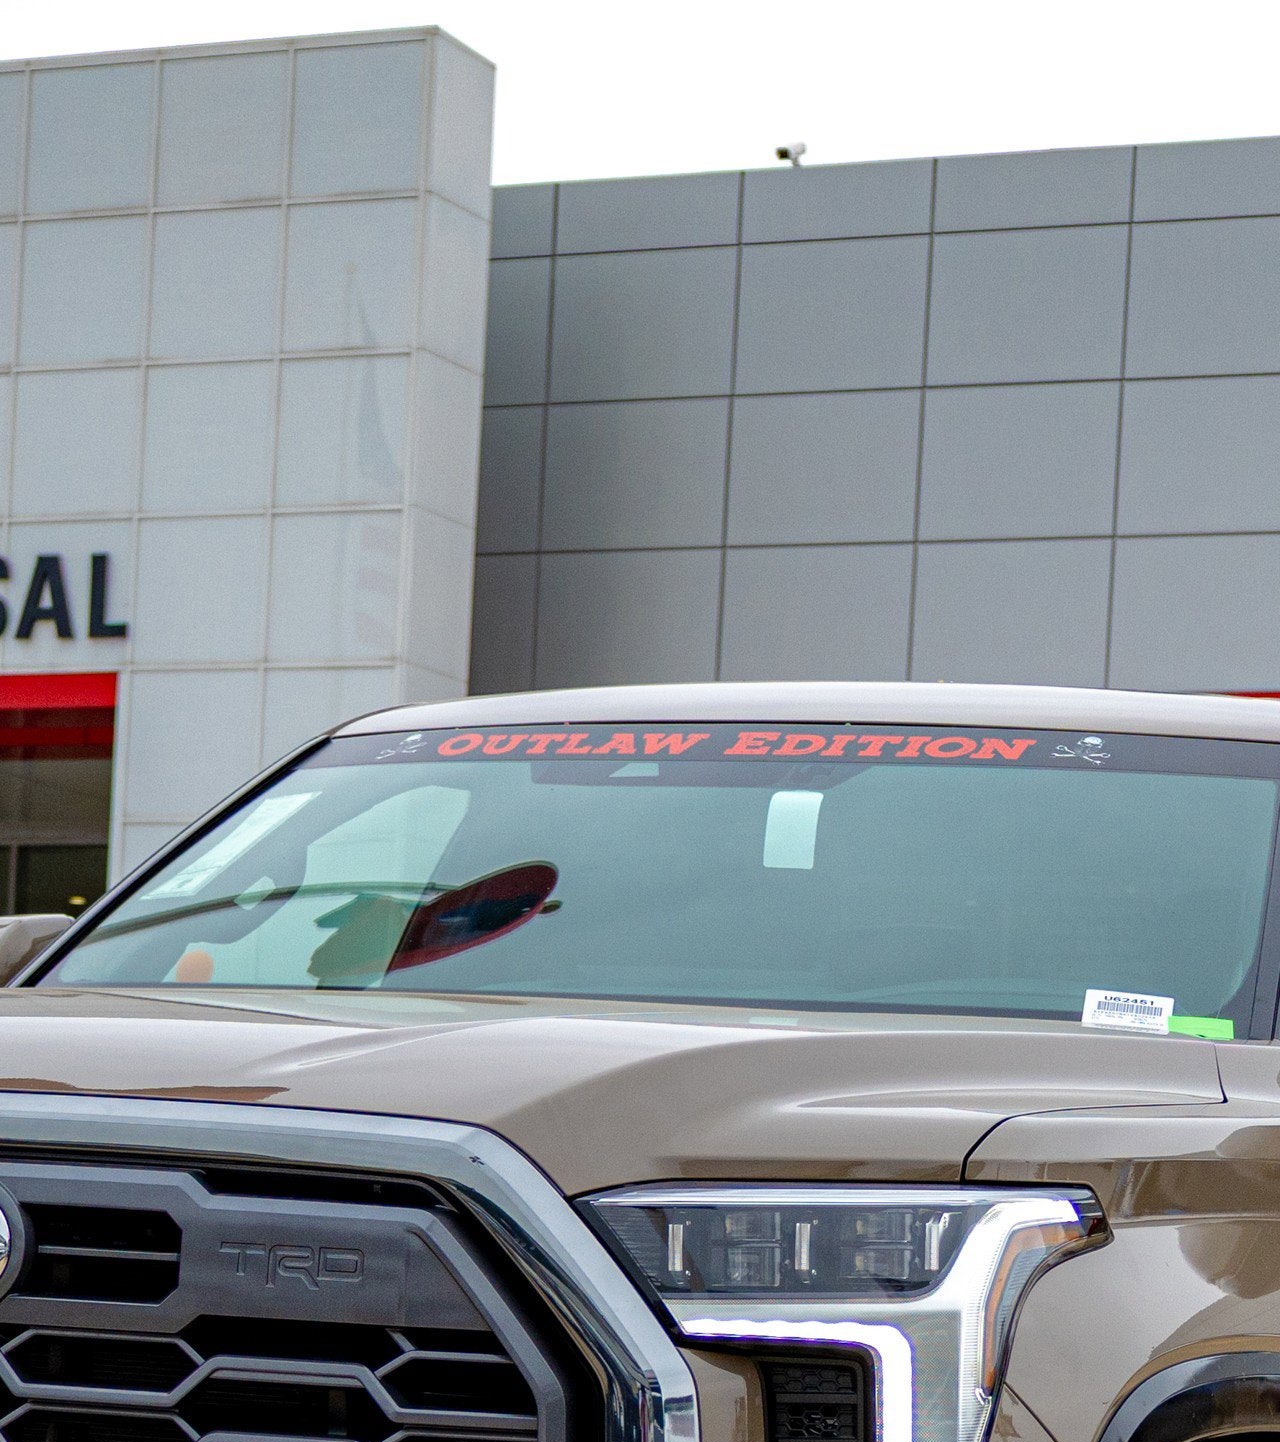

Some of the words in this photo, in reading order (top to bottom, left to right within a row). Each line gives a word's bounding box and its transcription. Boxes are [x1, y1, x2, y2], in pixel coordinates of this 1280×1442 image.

[437, 731, 710, 757] OUTLAW
[723, 731, 1036, 761] EDITION
[220, 1241, 365, 1290] TRD
